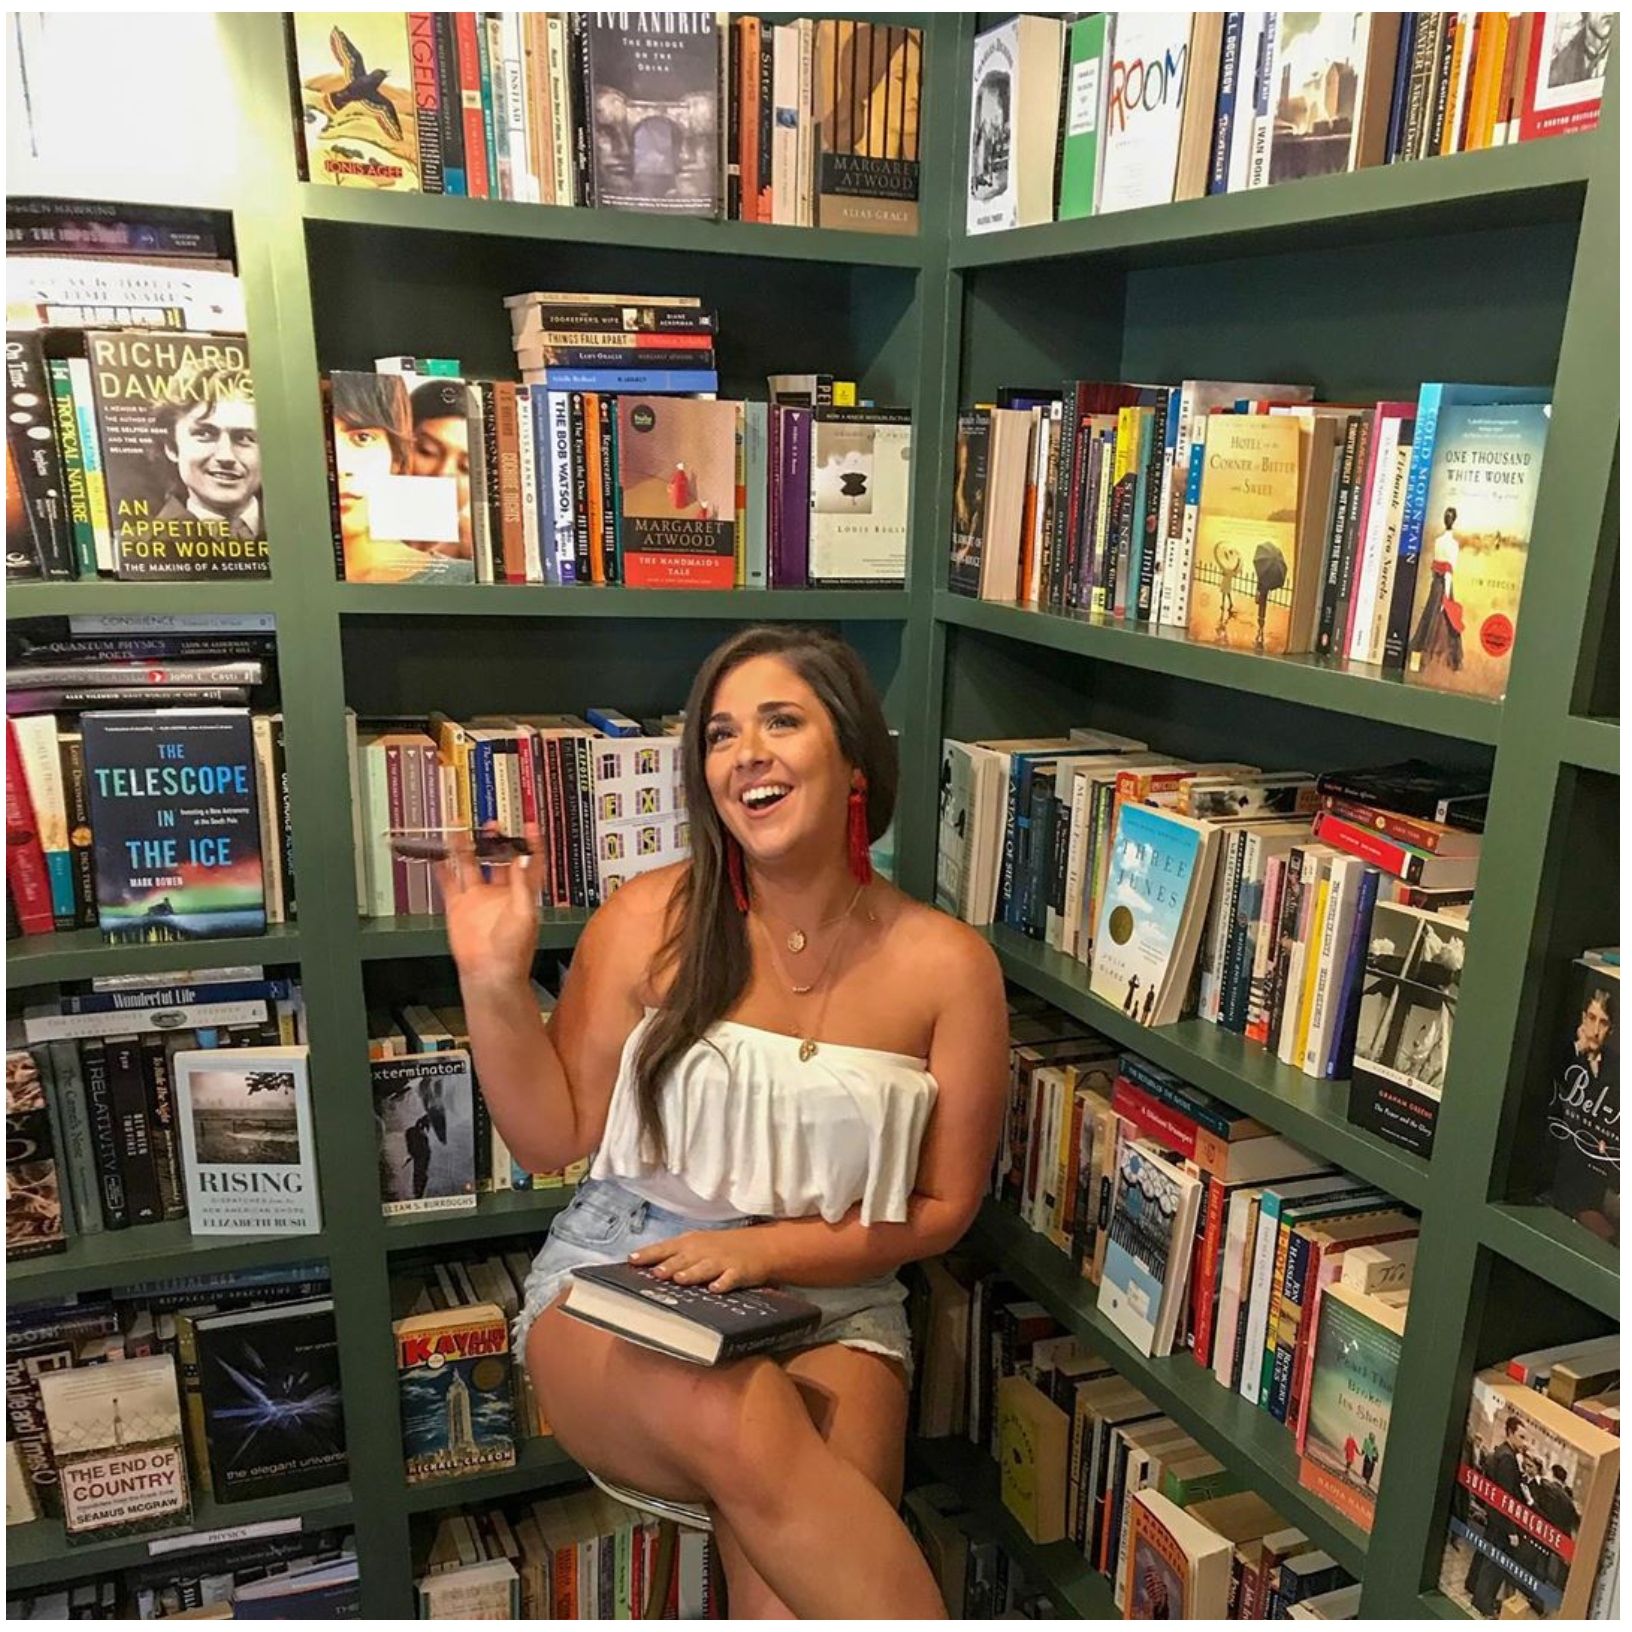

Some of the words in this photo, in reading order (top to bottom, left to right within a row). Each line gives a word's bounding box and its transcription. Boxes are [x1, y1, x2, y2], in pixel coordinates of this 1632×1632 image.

[409, 13, 437, 109] NGELS
[1109, 43, 1188, 137] ROOM
[842, 172, 913, 190] ATWOOD
[548, 333, 578, 344] THINGS
[580, 333, 600, 344] FALL
[601, 334, 628, 345] APART
[94, 340, 244, 370] RICHARD
[99, 373, 255, 402] DAWKINS
[555, 399, 566, 427] THE
[556, 429, 568, 459] BOB
[56, 394, 76, 463] TROPICAL
[67, 467, 89, 524] NATURE
[601, 433, 613, 497] Regeneration
[1445, 449, 1468, 464] ONE
[1471, 450, 1532, 466] THOUSAND
[1446, 468, 1481, 483] WHITE
[1485, 470, 1525, 485] WOMEN
[118, 499, 149, 516] AN
[1403, 465, 1430, 566] MOUNTAIN
[120, 520, 230, 537] APPETITE
[634, 518, 724, 535] MARGARET
[121, 540, 167, 558] FOR
[175, 540, 269, 558] WONDER
[643, 532, 716, 548] ATWOOD
[124, 562, 146, 572] THE
[149, 562, 191, 572] MAKING
[194, 562, 208, 572] OF
[211, 563, 219, 571] A
[639, 556, 657, 566] THE
[668, 566, 691, 576] TALE
[50, 641, 114, 653] QUANTUM
[117, 639, 166, 650] PHYSICS
[157, 743, 185, 759] THE
[94, 765, 249, 797] TELESCOPE
[157, 809, 175, 827] IN
[1006, 796, 1016, 837] STATE
[124, 840, 178, 869] THE
[189, 837, 233, 868] ICE
[1121, 838, 1188, 879] THREE
[129, 877, 153, 888] MARK
[154, 876, 184, 887] BOWEN
[1003, 861, 1013, 900] SIEGE
[1116, 869, 1179, 909] JUNES
[112, 990, 174, 1009] Wonderful
[175, 989, 196, 1004] Life
[370, 1060, 467, 1080] xterminator!
[1558, 1064, 1620, 1125] Bel-
[89, 1067, 118, 1175] RELATIVITY
[199, 1171, 303, 1194] RISING
[202, 1217, 272, 1229] ELIZABETH
[273, 1217, 308, 1228] RUSH
[1283, 1245, 1298, 1298] HASSLER
[1291, 1279, 1302, 1302] JON
[1370, 1370, 1394, 1393] Tha
[1356, 1403, 1388, 1432] Shell
[67, 1466, 106, 1483] THE
[109, 1458, 147, 1477] END
[150, 1453, 175, 1470] OF
[226, 1468, 248, 1480] the
[249, 1459, 298, 1478] elegant
[407, 1460, 459, 1476] MICHAEL
[73, 1470, 176, 1501] COUNTRY
[1465, 1469, 1497, 1503] SUITE
[75, 1507, 125, 1524] SEAMUS
[127, 1497, 178, 1514] MCGRAW
[207, 1530, 248, 1542] PHYSICS
